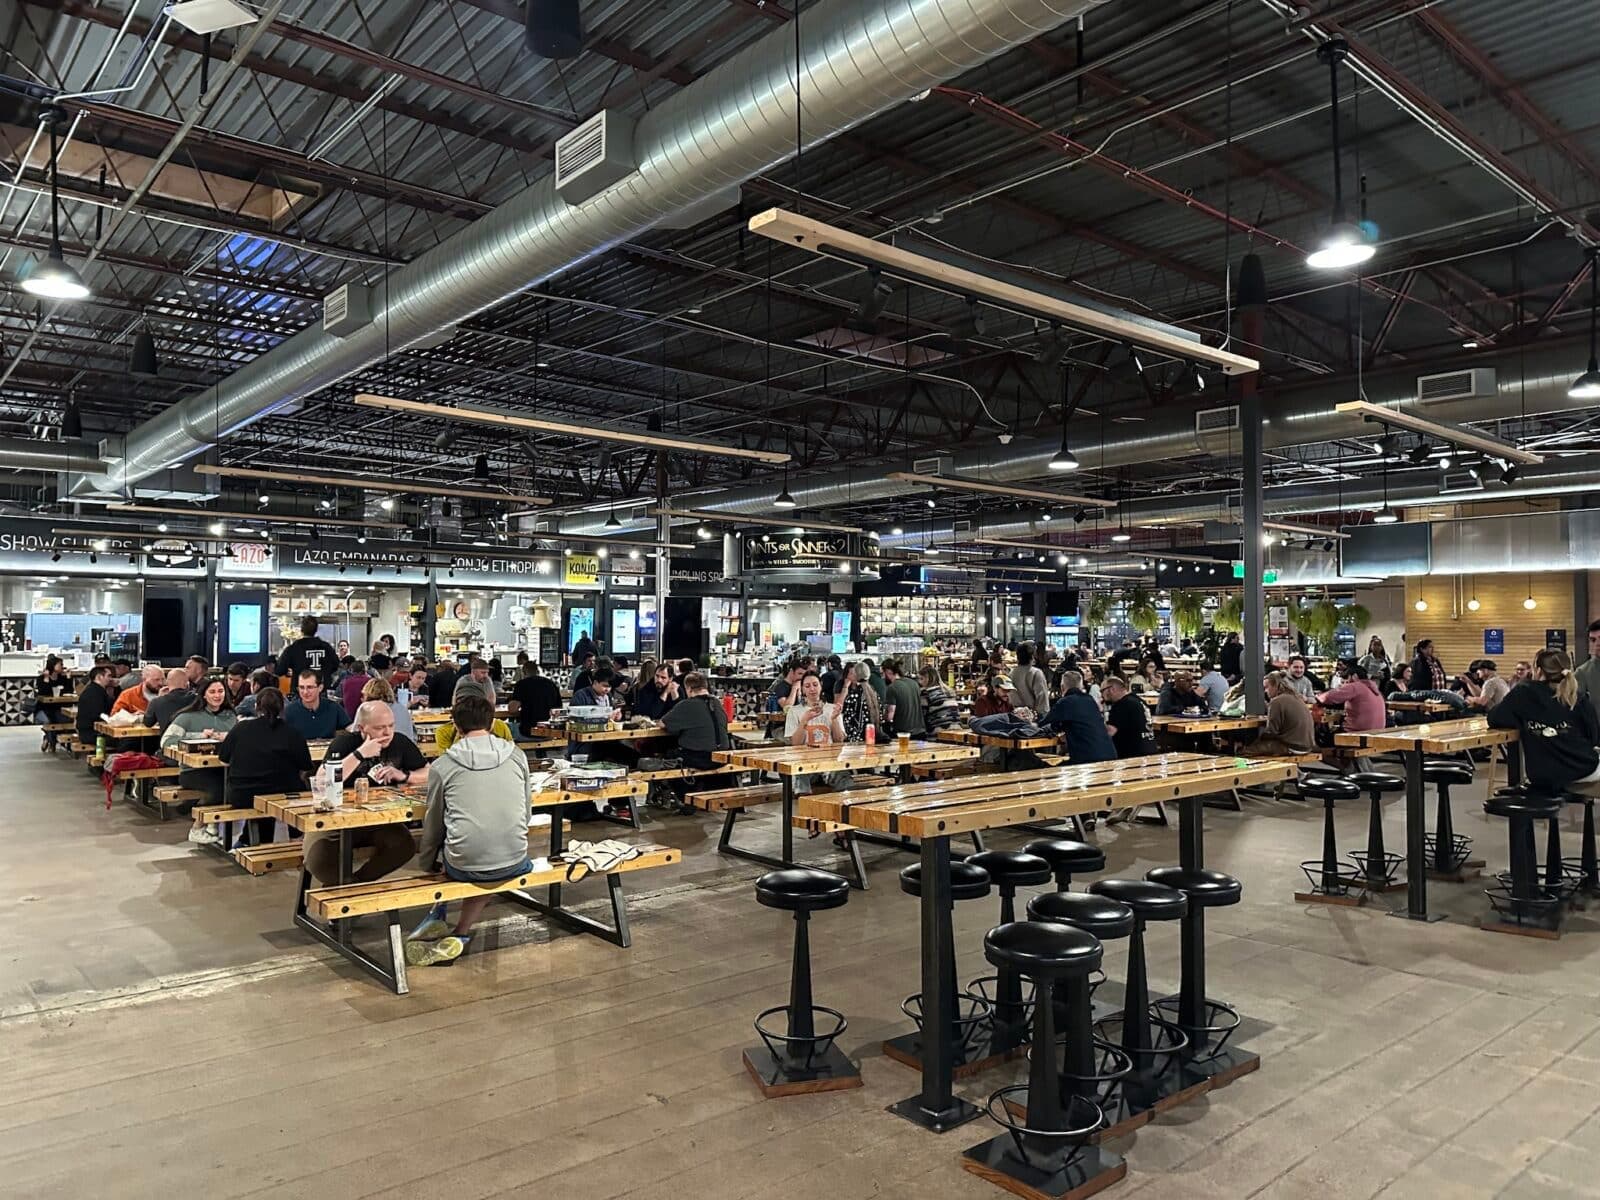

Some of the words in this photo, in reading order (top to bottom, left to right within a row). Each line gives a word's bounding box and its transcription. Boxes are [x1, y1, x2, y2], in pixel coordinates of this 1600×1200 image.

[0, 534, 57, 552] SHOW
[294, 549, 330, 565] LAZO
[305, 649, 325, 670] T
